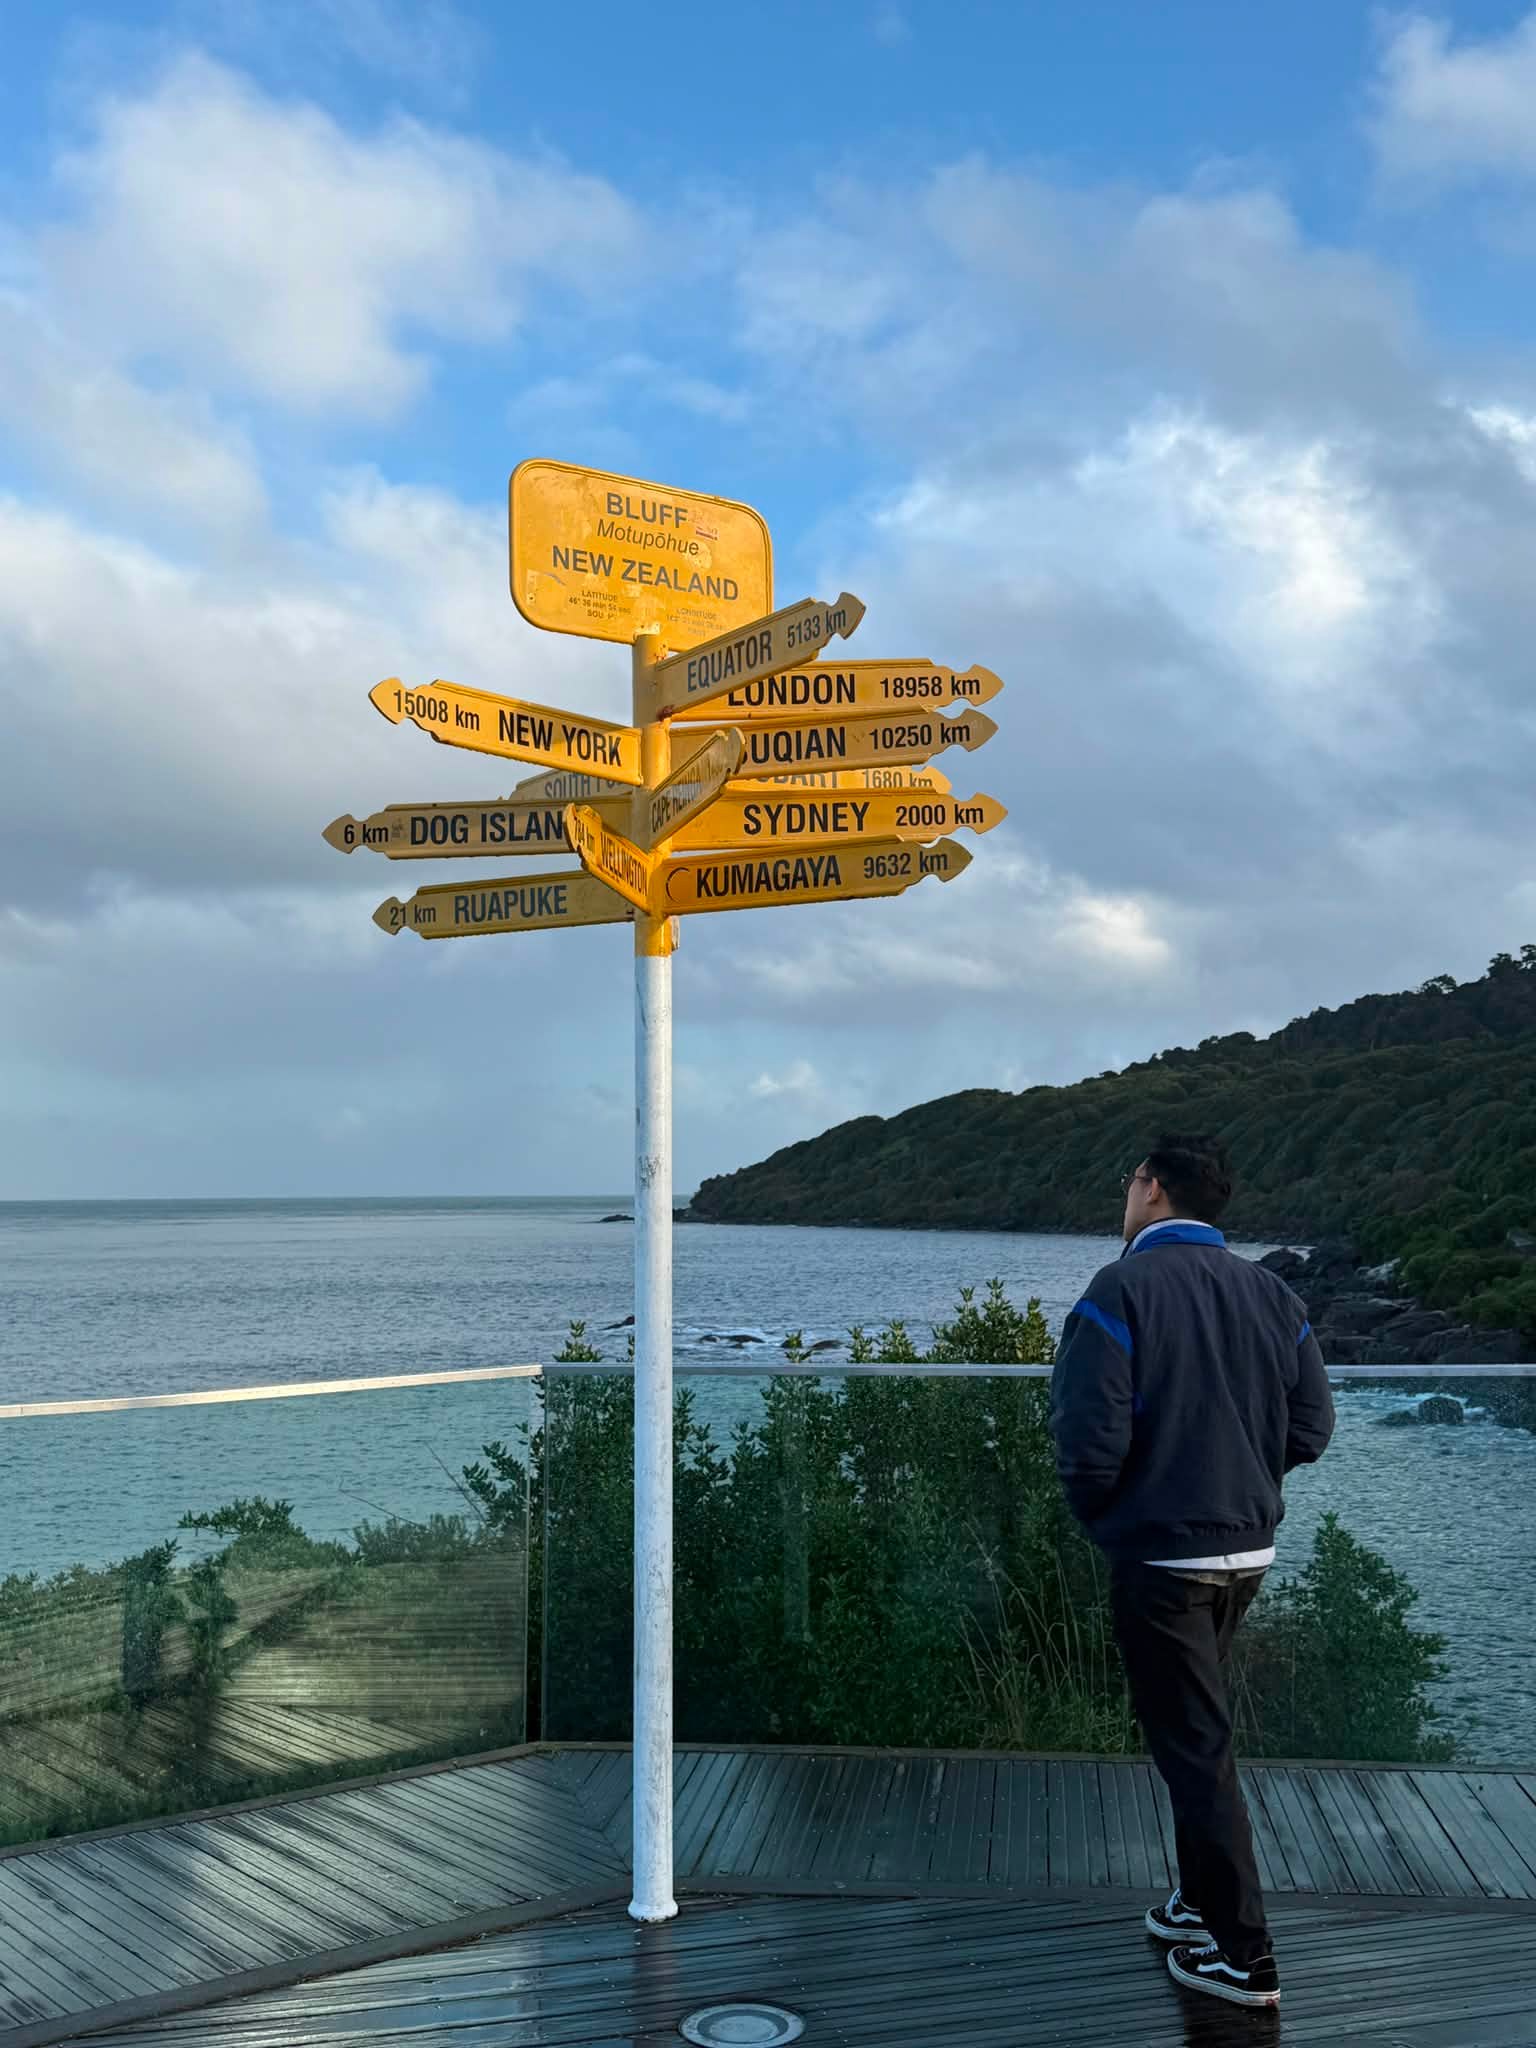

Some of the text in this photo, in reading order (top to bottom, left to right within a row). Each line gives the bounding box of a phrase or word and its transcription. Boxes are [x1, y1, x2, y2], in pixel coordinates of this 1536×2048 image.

[607, 492, 689, 529] BLUFF
[597, 518, 699, 556] Motupōhue
[552, 544, 739, 601] NEW ZEALAND
[582, 590, 618, 603] LATITUDE
[687, 608, 846, 693] EQUATOR 5133 km
[728, 673, 980, 707] LONDON 18958 km
[393, 689, 622, 767] 15008 km NEW YORK
[742, 722, 971, 765] UQIAN 10250 km
[863, 768, 933, 789] 1680 km
[343, 811, 563, 846] 6 km DOG ISLAN
[743, 801, 984, 835] SYDNEY 2000 km
[600, 831, 648, 896] WELLINGTON
[696, 850, 948, 898] KUMAGAYA 9632 km
[390, 885, 567, 926] 21 km RUAPUKE
